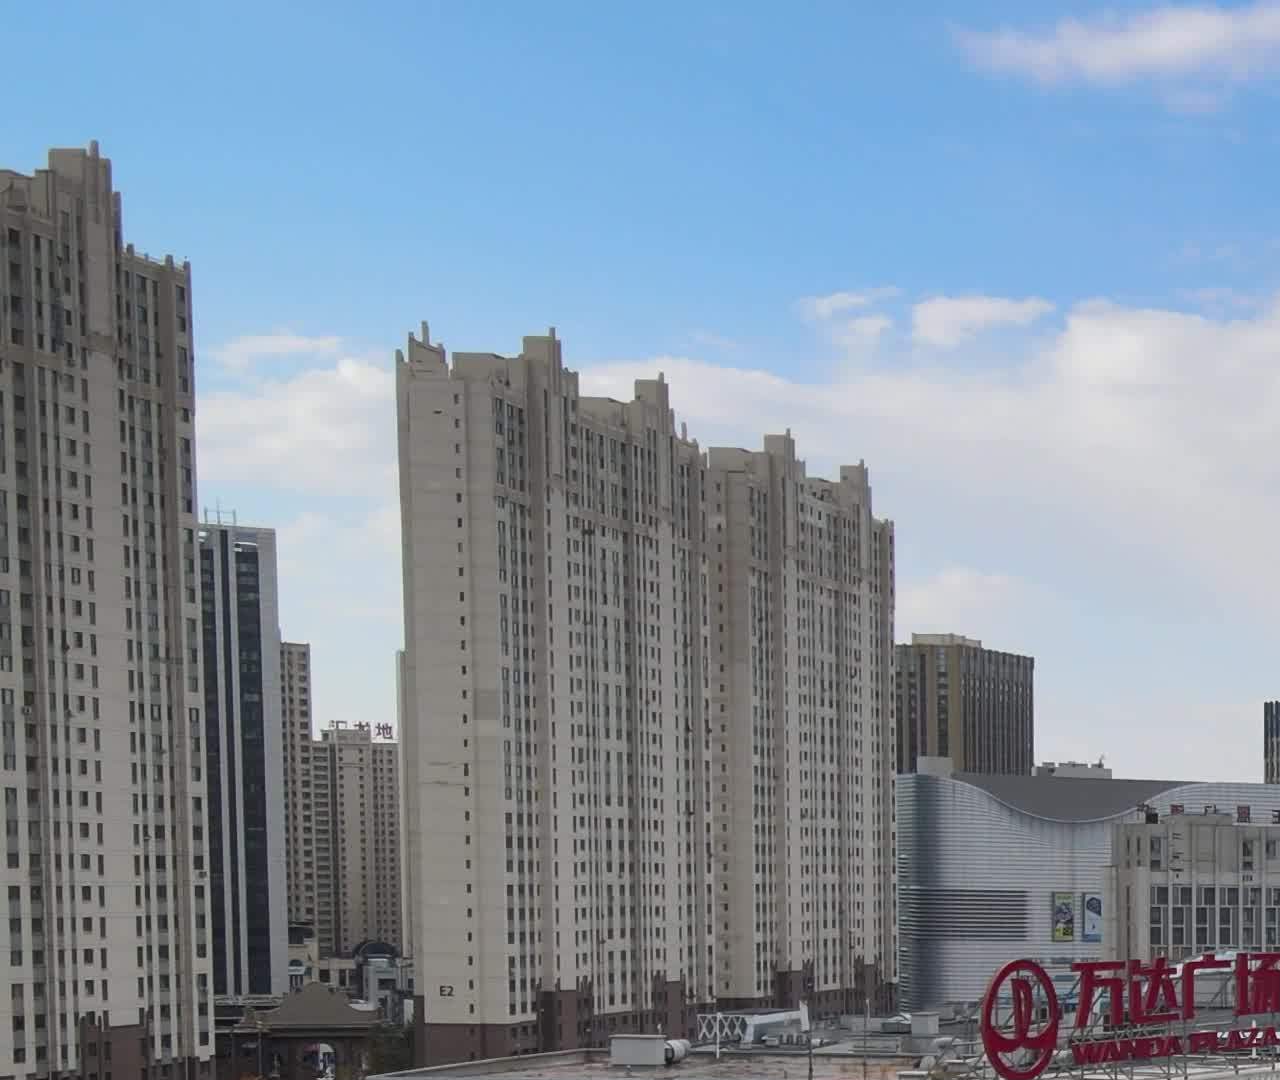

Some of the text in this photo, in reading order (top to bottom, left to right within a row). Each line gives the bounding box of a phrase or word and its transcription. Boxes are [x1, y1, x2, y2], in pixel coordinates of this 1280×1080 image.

[440, 985, 455, 997] E2
[1071, 1027, 1280, 1065] WANDA PLAZA
